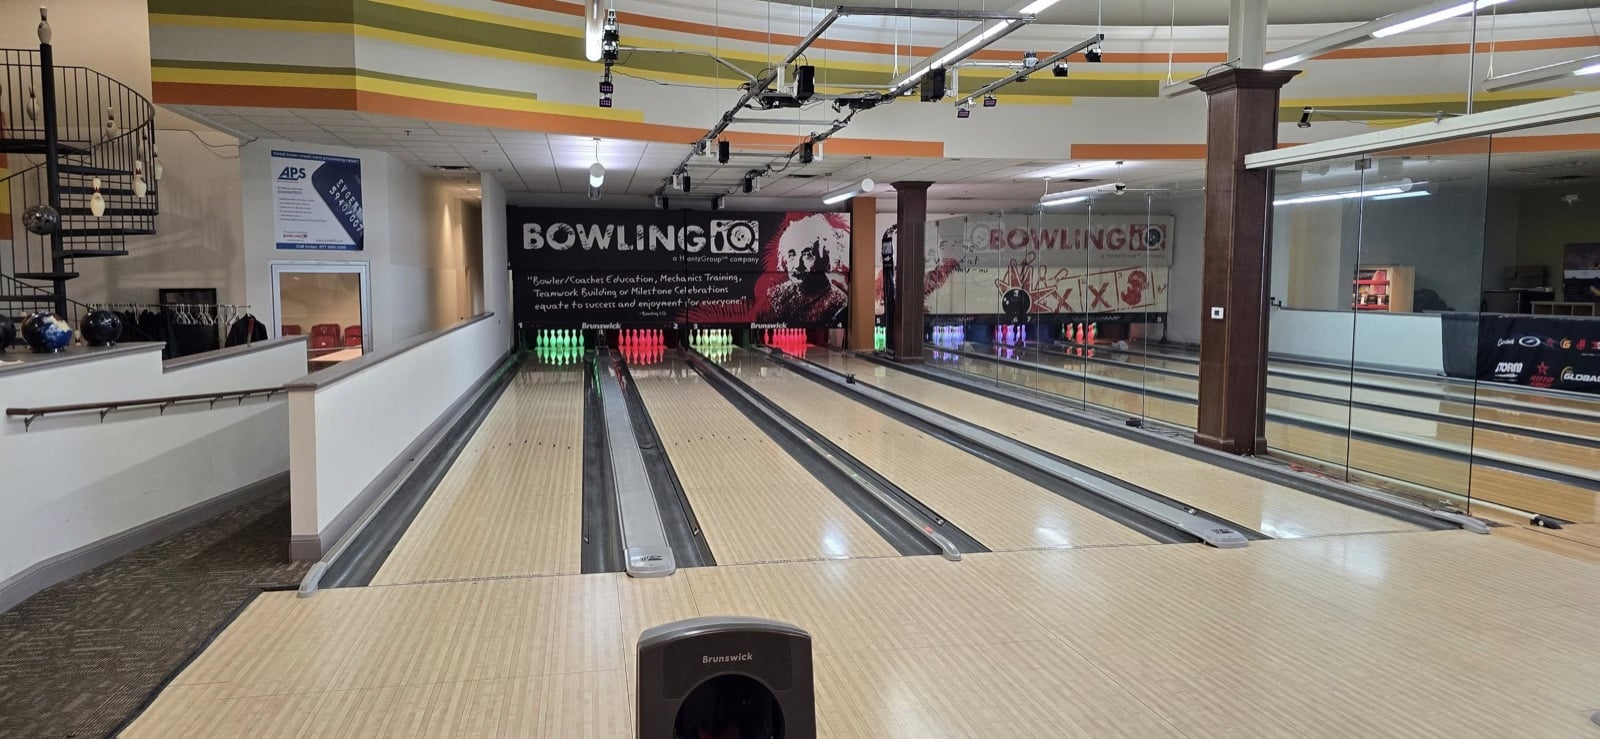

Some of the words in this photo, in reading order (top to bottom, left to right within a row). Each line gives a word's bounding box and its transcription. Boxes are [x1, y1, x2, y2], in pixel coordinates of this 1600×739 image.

[277, 166, 307, 181] APS
[522, 221, 707, 253] BOWLING
[989, 227, 1127, 250] BOWLING
[527, 274, 605, 286] "Bowler/Coaches
[605, 274, 659, 284] Education,
[660, 273, 703, 282] Mechanics
[704, 272, 743, 283] Training,
[533, 287, 580, 298] Teamwork
[581, 287, 618, 299] Building
[630, 285, 673, 295] Milestone
[674, 284, 729, 296] Celebrations
[1087, 281, 1113, 311] X
[534, 300, 569, 313] equate
[570, 299, 584, 309] to
[585, 301, 616, 309] success
[617, 298, 636, 308] and
[638, 298, 683, 310] enjoyment
[581, 321, 623, 330] Brunswick
[750, 321, 788, 330] Brunswick
[702, 652, 753, 668] Brunswick
